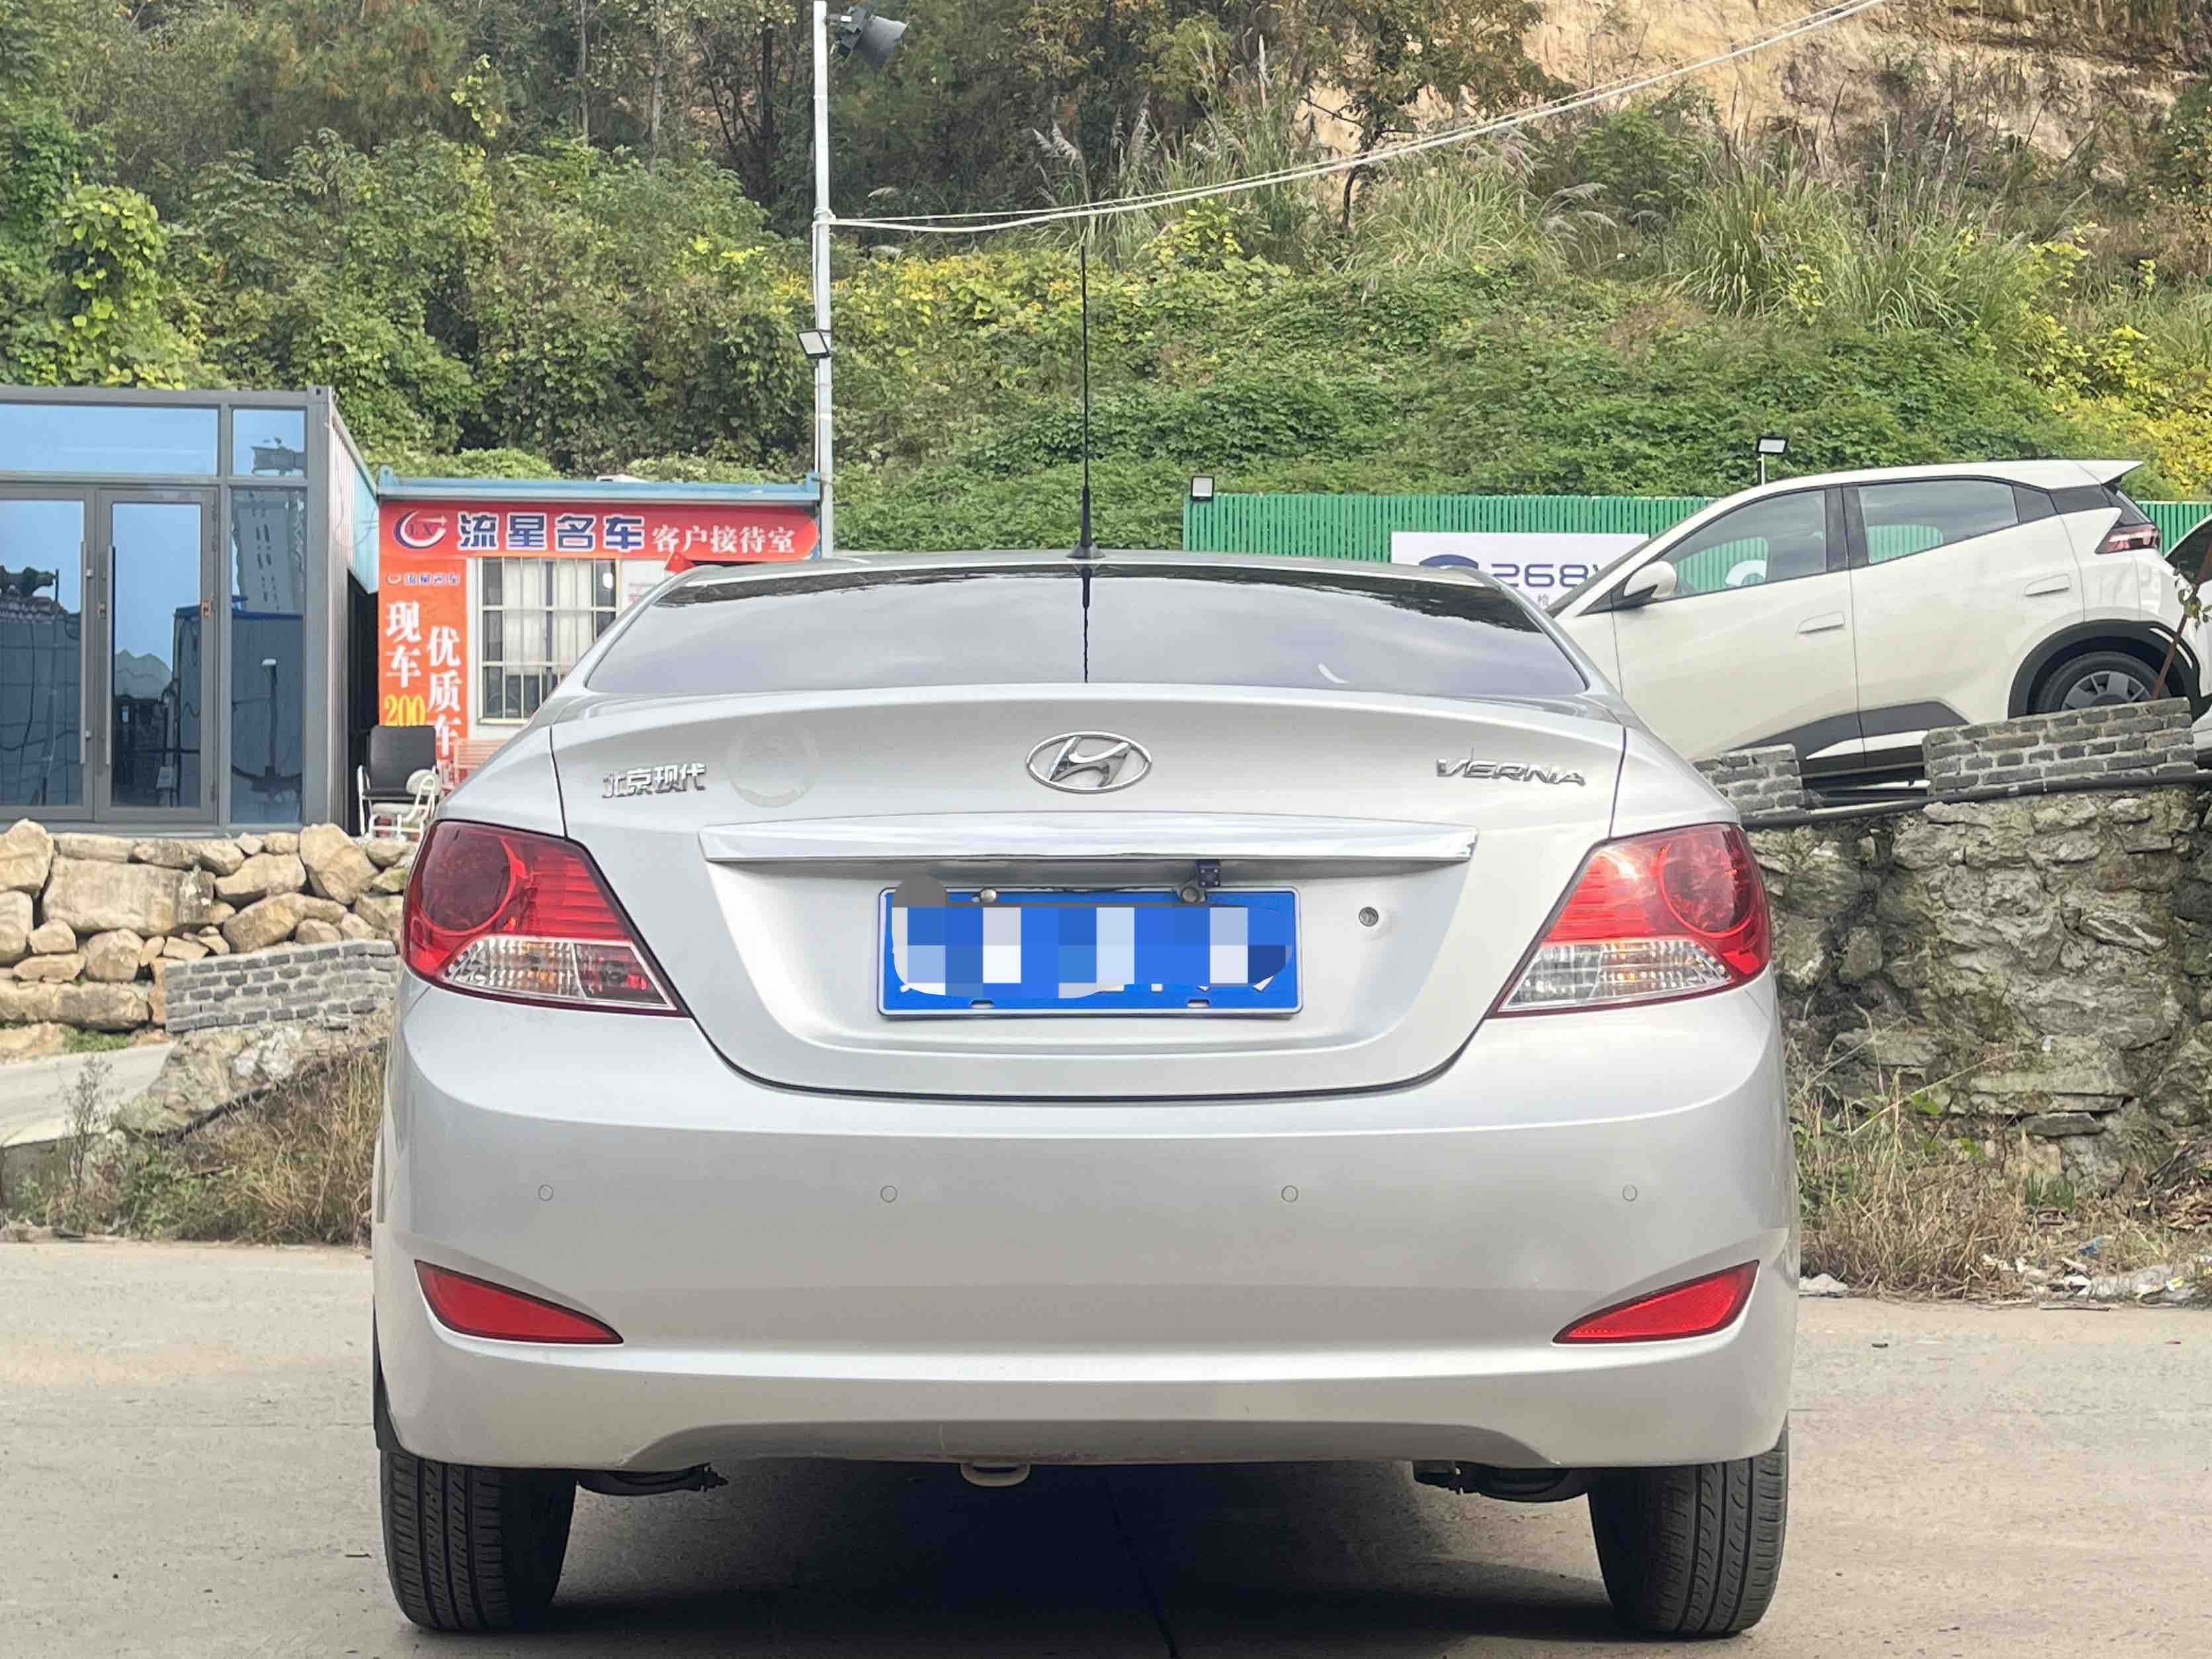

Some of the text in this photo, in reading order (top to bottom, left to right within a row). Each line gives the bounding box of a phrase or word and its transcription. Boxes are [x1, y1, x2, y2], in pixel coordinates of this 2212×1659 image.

[458, 512, 796, 554] 流星名车 客户接待室
[1491, 563, 1599, 588] 268
[386, 601, 422, 688] 现车
[384, 694, 425, 726] 200
[602, 762, 706, 798] 北京现代
[1436, 758, 1586, 787] VERNA
